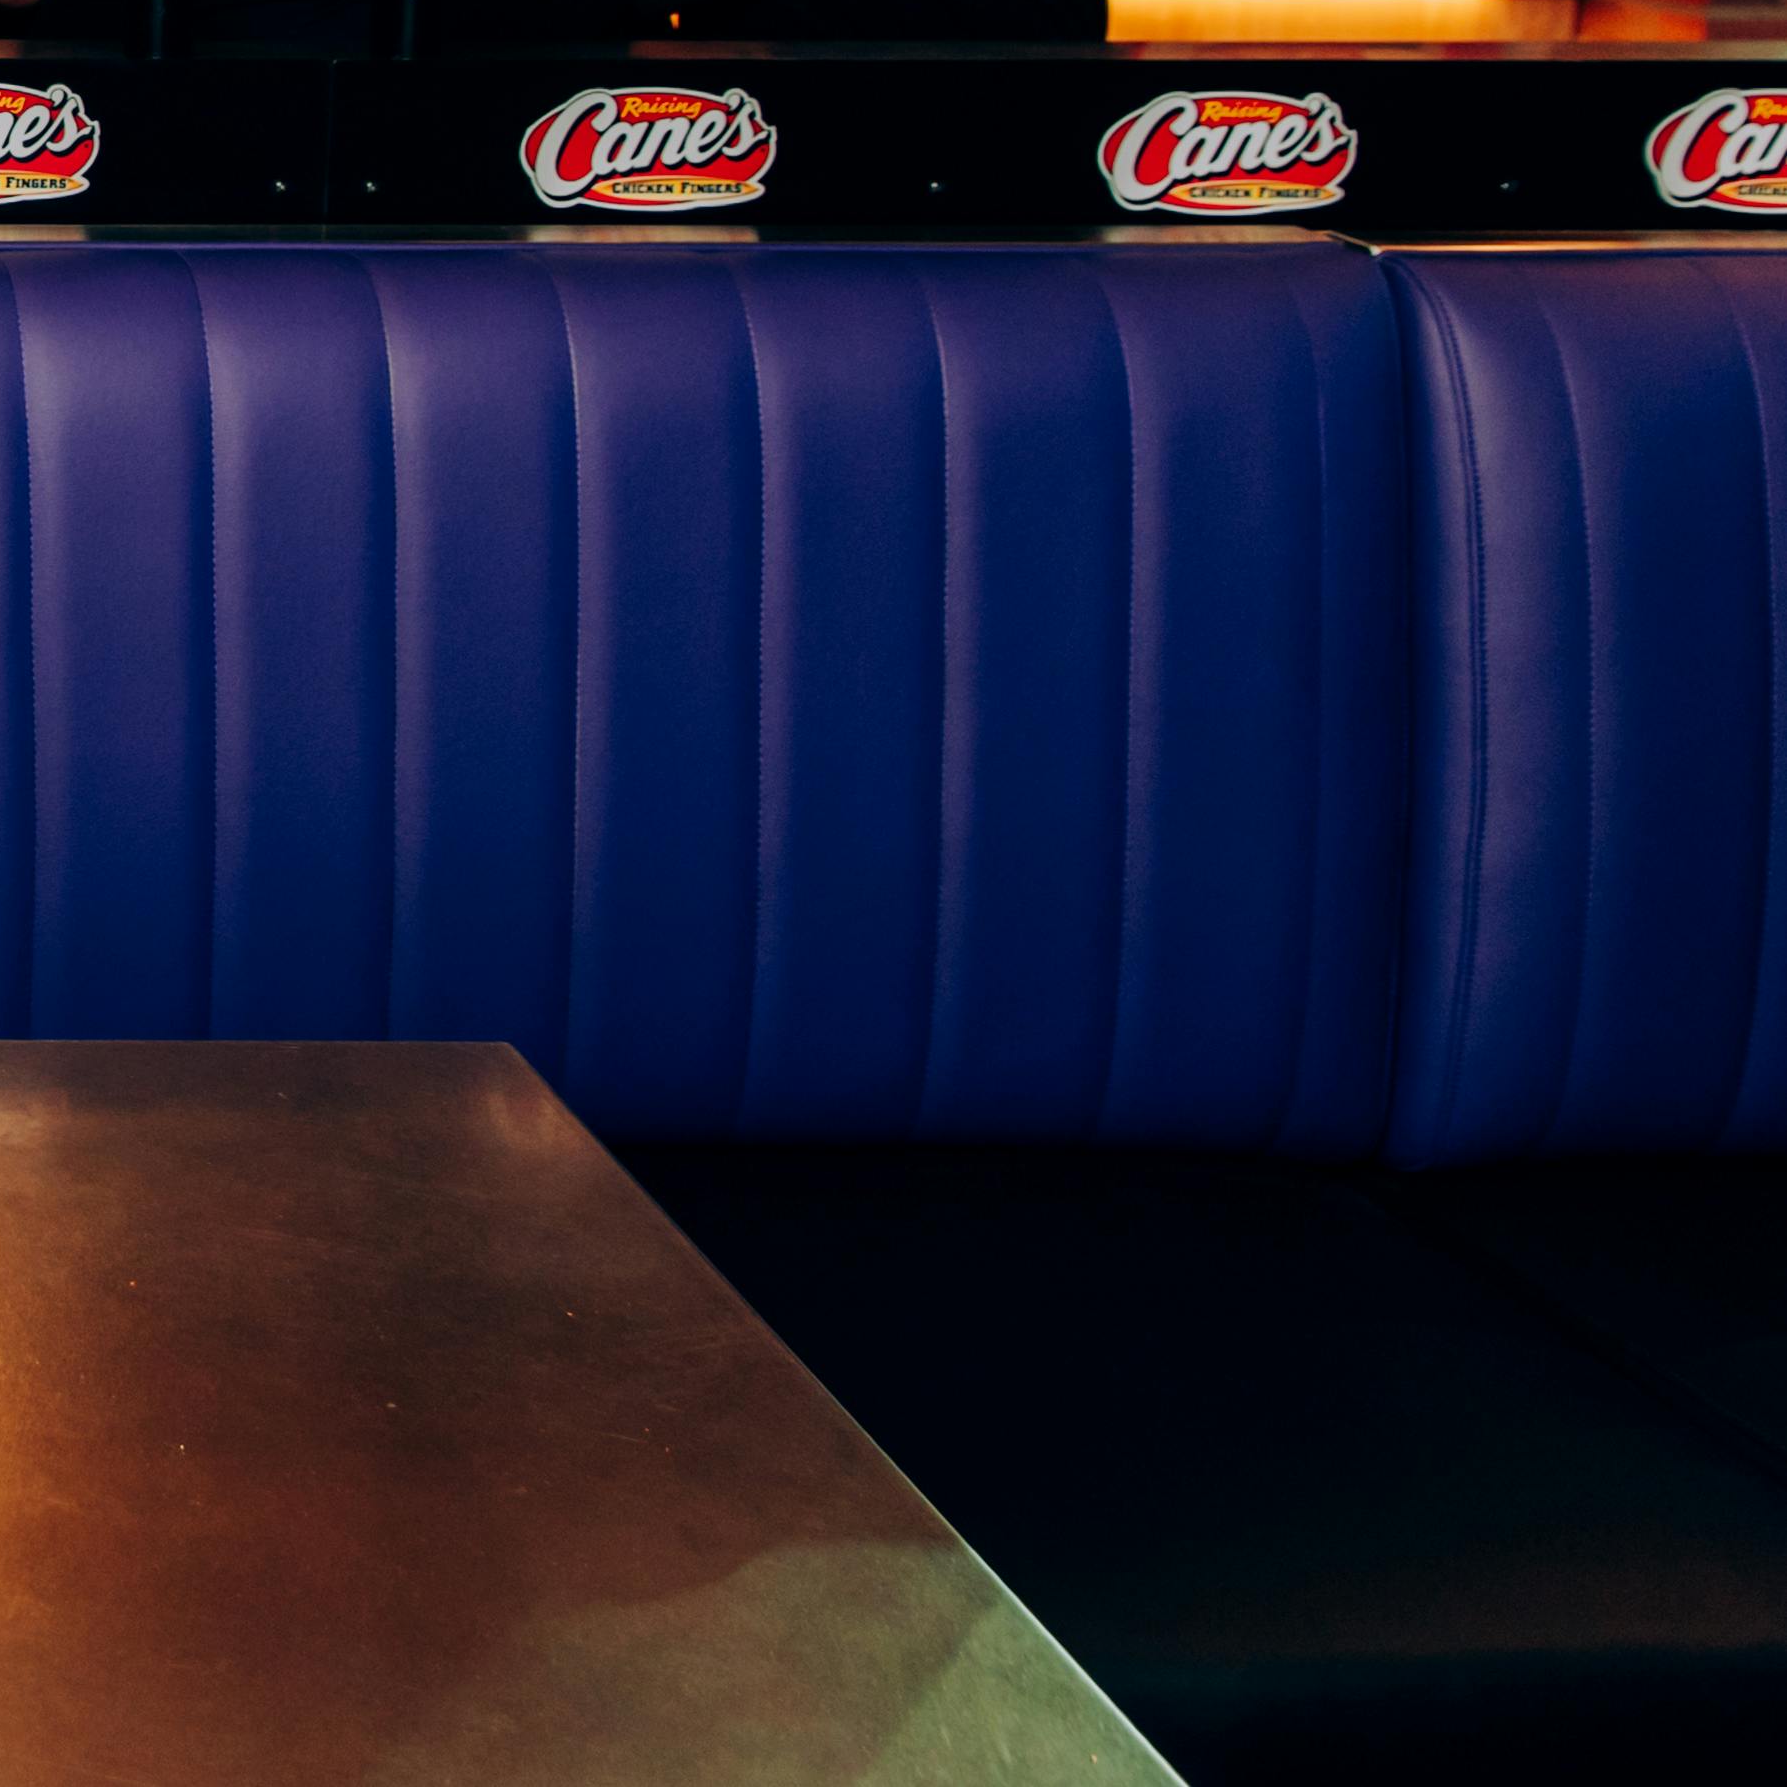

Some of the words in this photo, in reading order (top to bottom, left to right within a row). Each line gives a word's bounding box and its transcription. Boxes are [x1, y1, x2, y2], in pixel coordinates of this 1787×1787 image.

[621, 97, 702, 119] Raising
[1199, 101, 1282, 123] Raising
[534, 91, 768, 197] Cane's
[1113, 95, 1349, 201] Cane's
[6, 176, 66, 189] FINGERS
[612, 182, 674, 194] CHICKEN
[681, 181, 742, 194] FINGERS
